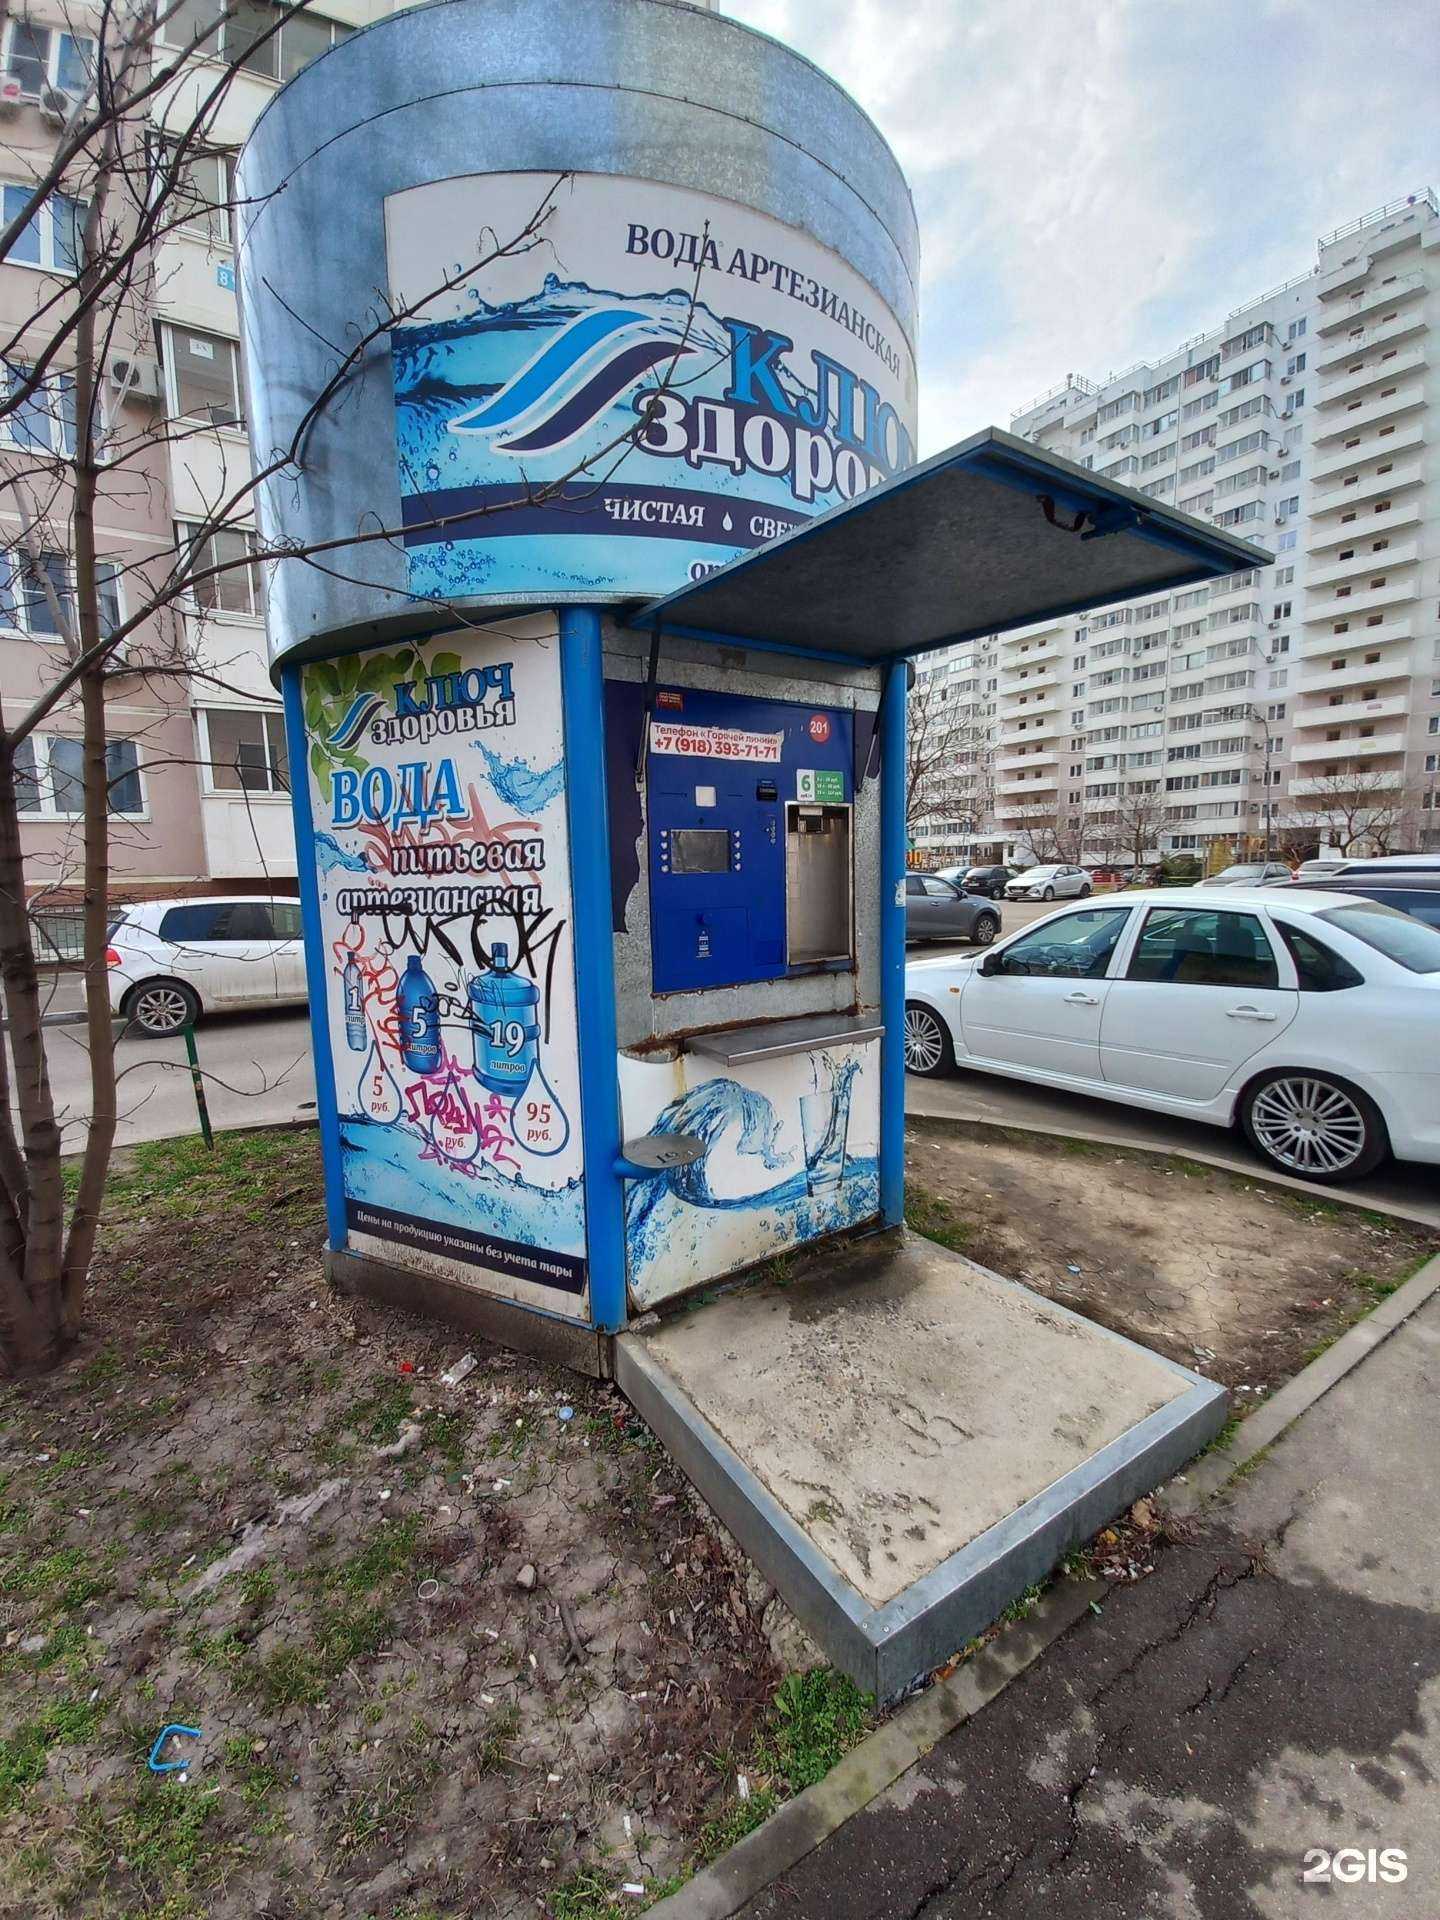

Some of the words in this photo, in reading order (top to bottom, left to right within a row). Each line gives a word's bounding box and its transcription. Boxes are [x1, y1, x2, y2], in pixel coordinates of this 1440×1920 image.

[625, 223, 722, 272] ВОДА
[726, 246, 900, 381] АРТЕЗИАНСКАЯ
[634, 391, 888, 503] здоро
[604, 497, 706, 528] ЧИСТАЯ
[749, 514, 800, 539] СВЕ
[393, 661, 516, 717] КЛЮЧ
[654, 725, 699, 738] Телефон
[810, 721, 828, 734] 201
[655, 737, 672, 750] +7
[675, 737, 712, 755] (918)
[714, 742, 778, 760] 393-71-71
[330, 758, 468, 834] ВОДА
[801, 774, 811, 792] 6
[391, 839, 546, 876] питьевая
[337, 884, 543, 916] артезианская
[348, 985, 362, 1012] 1
[412, 1005, 428, 1039] 5
[490, 1020, 525, 1057] 19
[490, 1060, 527, 1073] литров
[373, 1076, 383, 1097] 5
[371, 1101, 390, 1114] руб.
[526, 1102, 551, 1124] 95
[527, 1129, 552, 1141] руб.
[357, 1210, 380, 1224] Цены
[382, 1219, 392, 1229] на
[393, 1223, 443, 1242] продукцию
[443, 1234, 484, 1254] указаны
[486, 1244, 502, 1258] без
[503, 1253, 537, 1269] учета
[539, 1262, 573, 1277] тары
